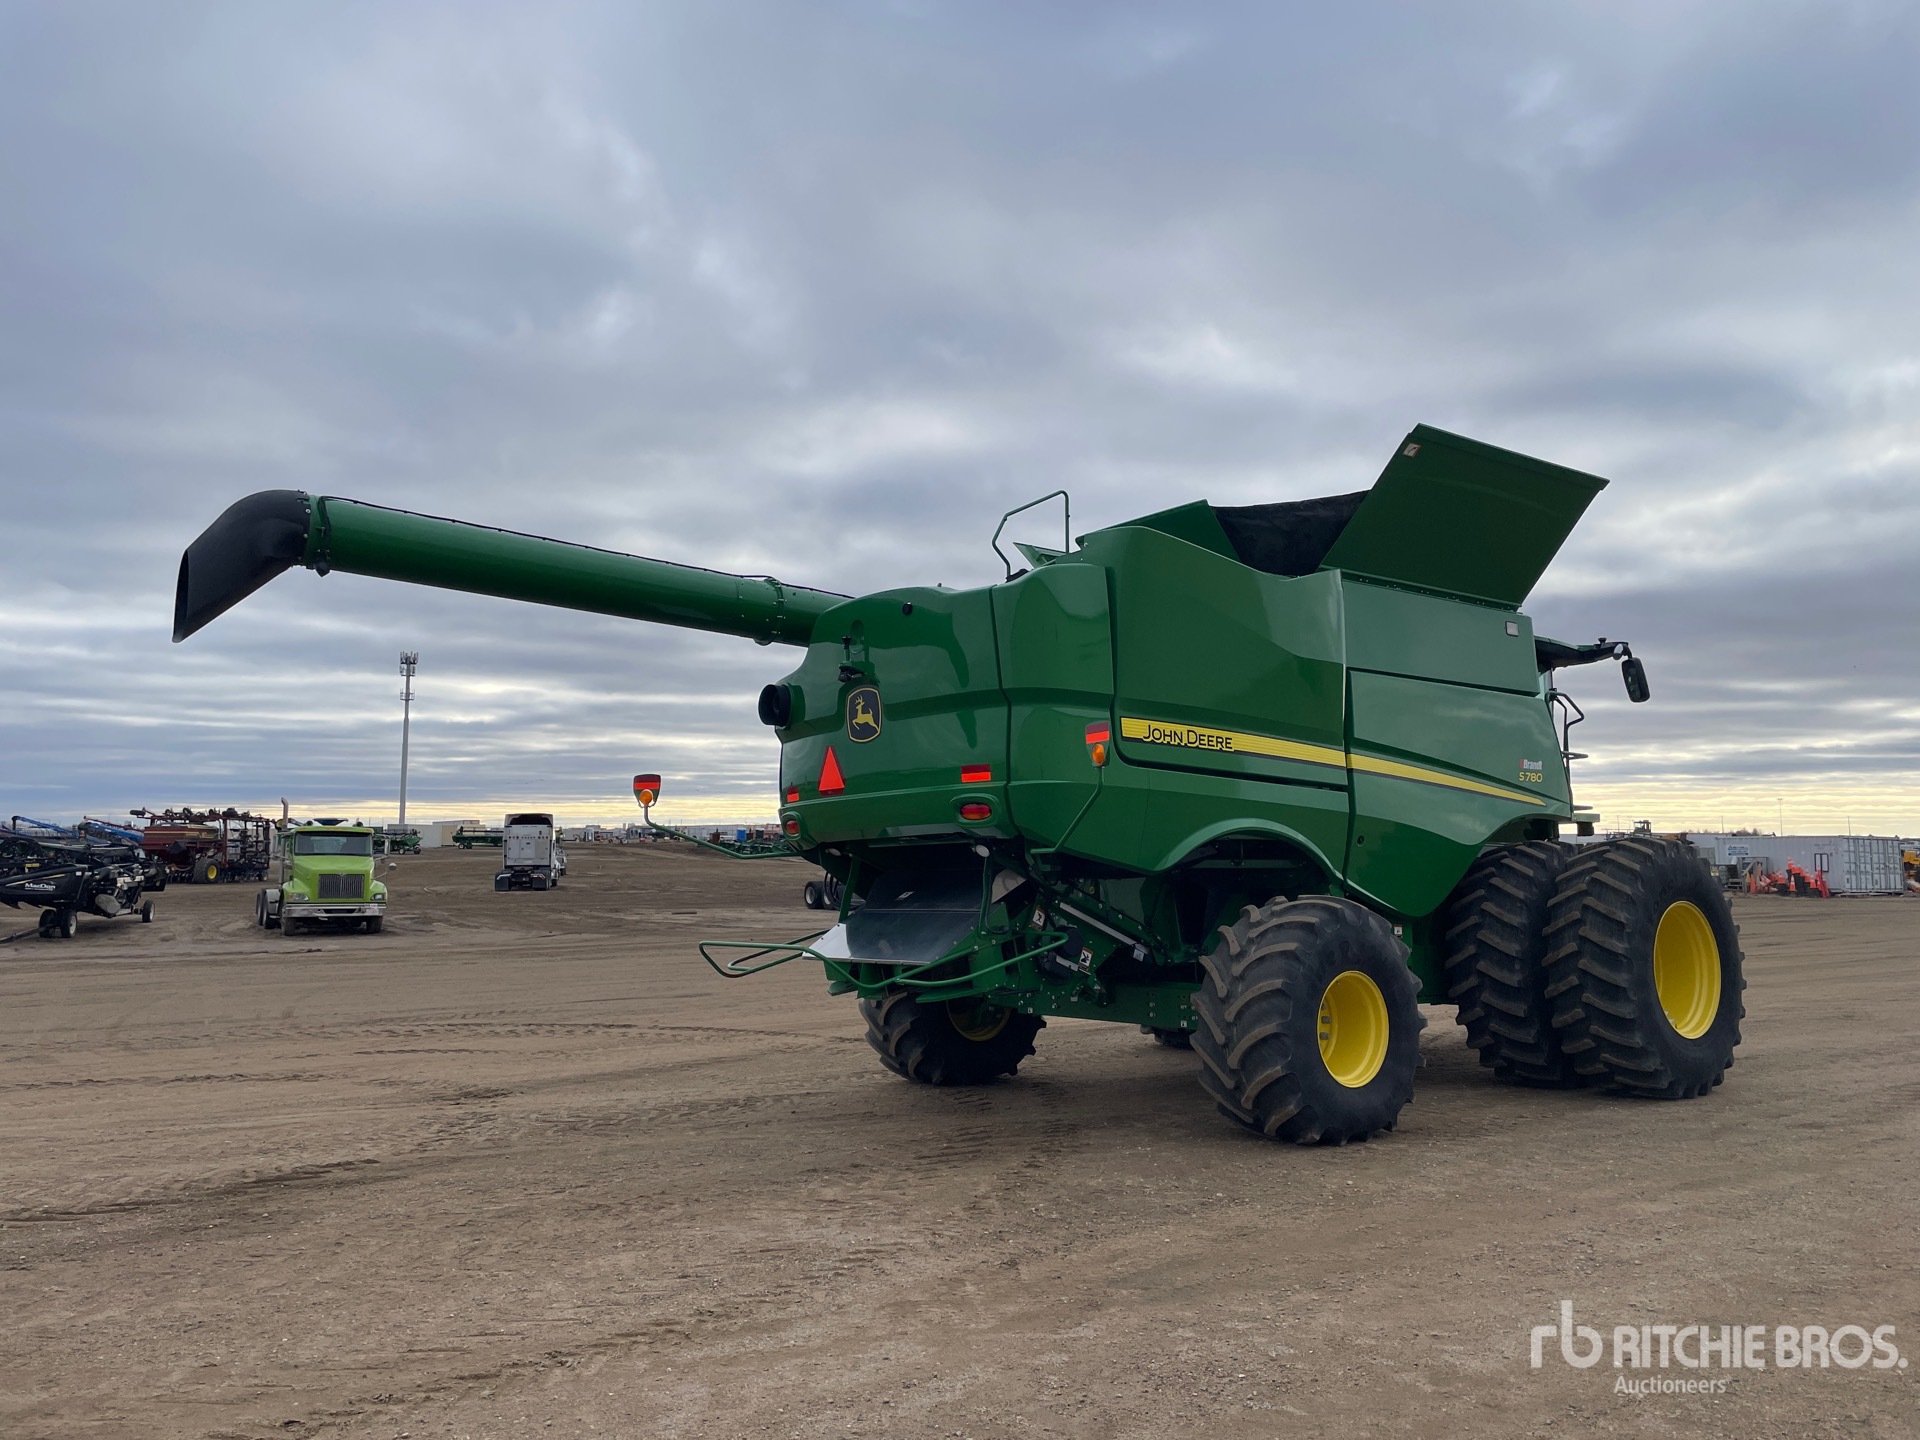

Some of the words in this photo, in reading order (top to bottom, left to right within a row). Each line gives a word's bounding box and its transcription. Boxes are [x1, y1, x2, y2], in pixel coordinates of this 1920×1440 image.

[1142, 724, 1183, 743] JOHN
[1187, 729, 1233, 750] DEERE
[1519, 771, 1543, 783] S780
